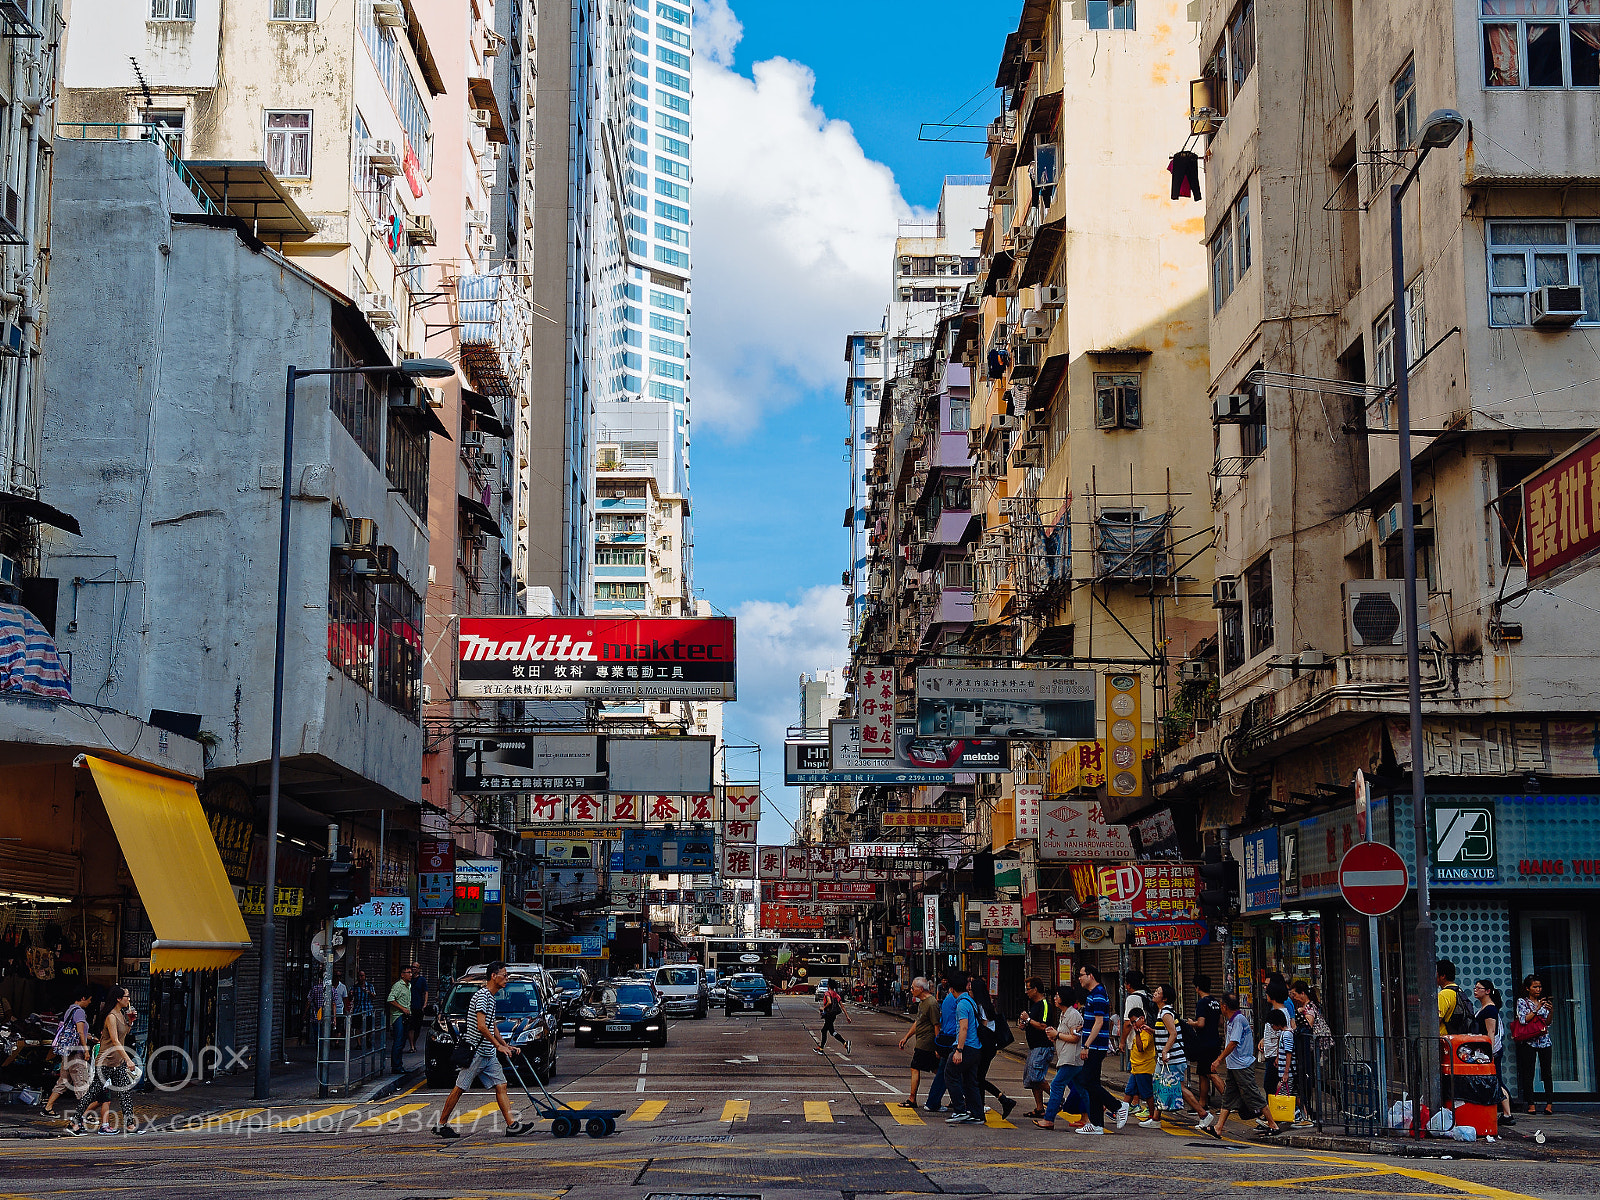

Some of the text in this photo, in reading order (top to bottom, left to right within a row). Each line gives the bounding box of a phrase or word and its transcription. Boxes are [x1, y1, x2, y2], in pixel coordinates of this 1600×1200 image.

[603, 639, 723, 661] maktec
[512, 664, 684, 678] 牧田 牧科 專業電動工具
[584, 686, 721, 695] TRIPLE METAL & MACHINERY LIMITED
[879, 670, 894, 744] 奶茶咖啡店
[962, 751, 1000, 761] metabo
[1079, 741, 1105, 771] 財
[422, 841, 450, 855] 三寶
[456, 864, 499, 873] anasonic
[1144, 867, 1195, 878] 膠片招牌
[1519, 860, 1564, 874] HANG
[1145, 877, 1196, 888] 彩色海報
[1145, 888, 1197, 899] 優質印章
[1145, 899, 1196, 910] 彩色咭片
[987, 905, 1014, 918] 全球
